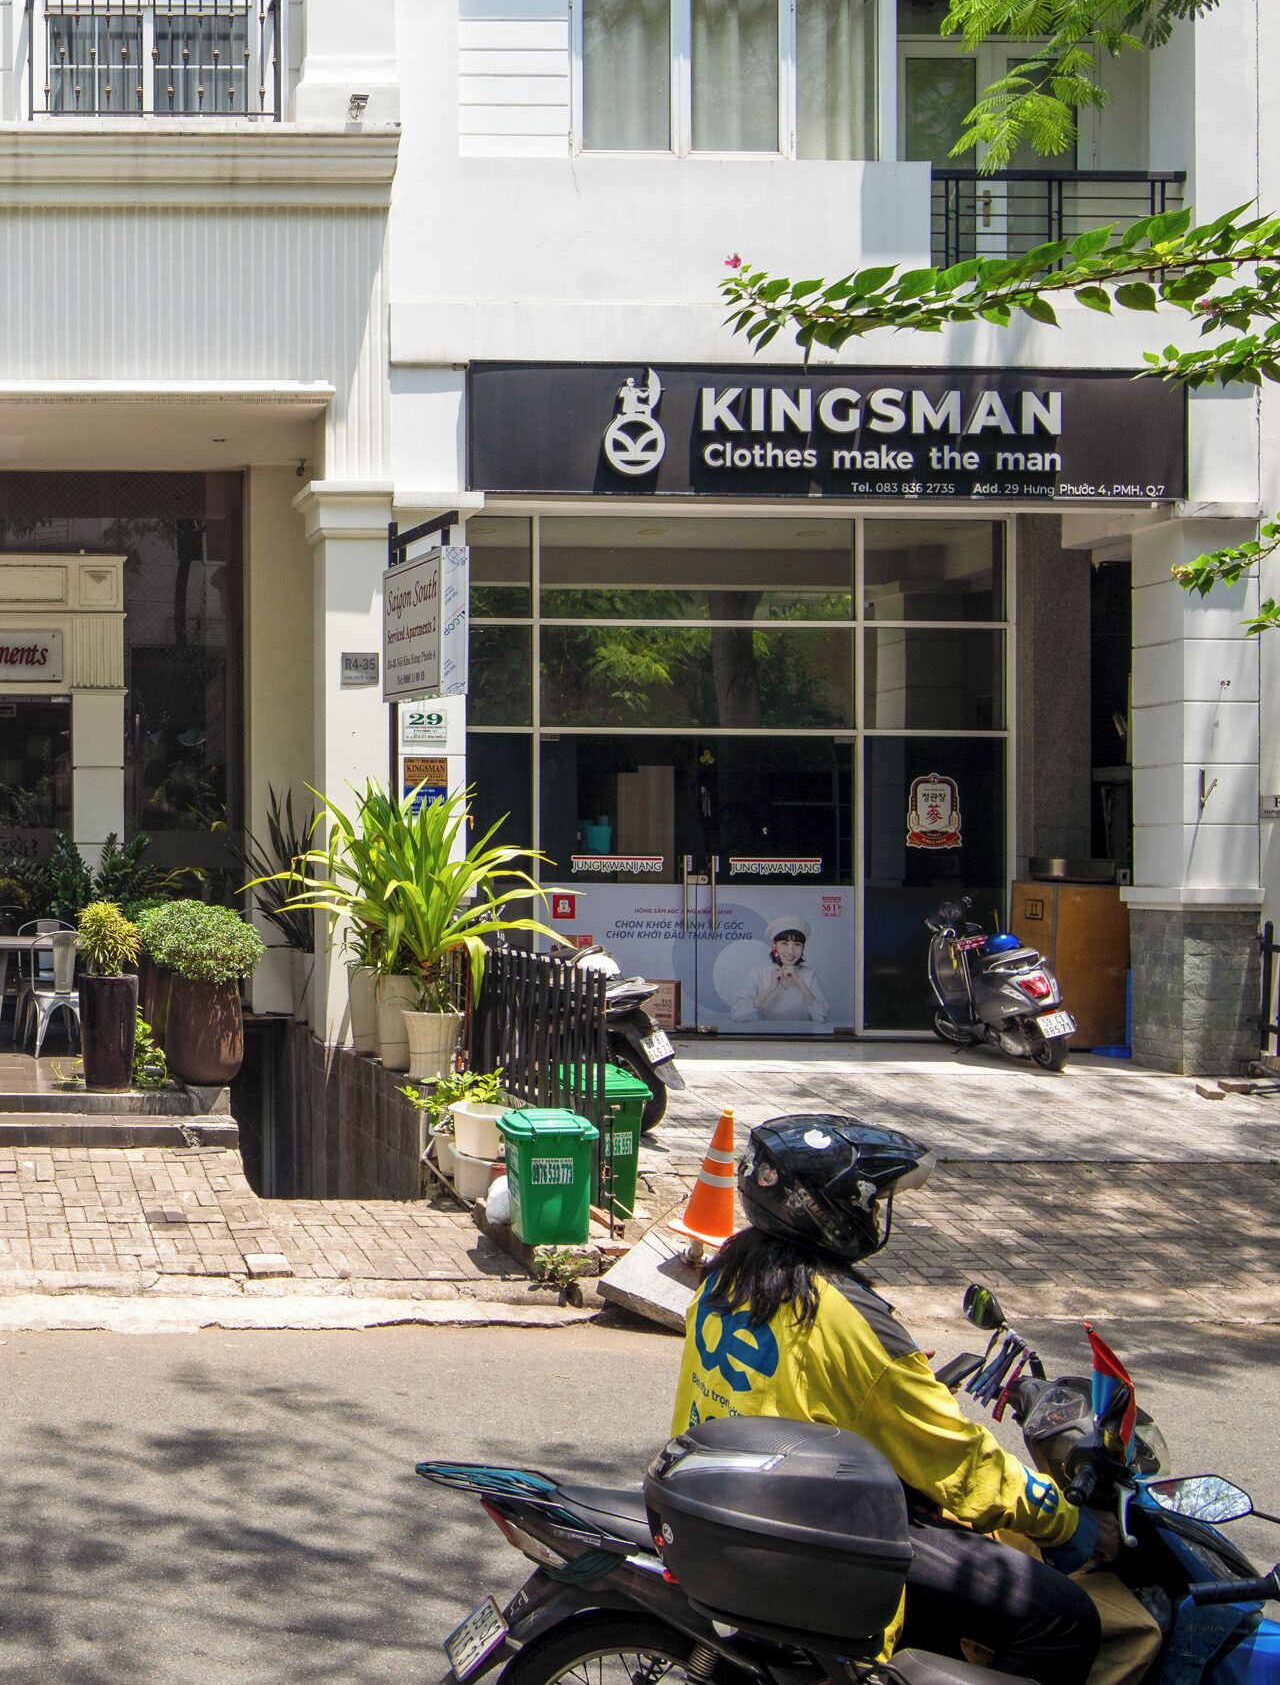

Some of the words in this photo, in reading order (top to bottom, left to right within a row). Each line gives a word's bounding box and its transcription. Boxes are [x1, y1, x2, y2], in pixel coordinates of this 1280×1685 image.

[700, 387, 1062, 435] KINGSMAN
[703, 442, 817, 468] Clothes
[832, 445, 914, 470] make
[930, 446, 980, 471] the
[996, 450, 1062, 472] man
[851, 482, 872, 493] Tel.
[875, 482, 898, 493] 083
[901, 483, 923, 493] 836
[926, 483, 955, 494] 2735
[972, 483, 1001, 494] Add.
[1004, 483, 1019, 494] 29
[1023, 484, 1055, 496] Hưng
[1059, 482, 1095, 495] Phước
[1146, 485, 1165, 497] Q.7
[386, 587, 412, 619] Saigon
[412, 569, 437, 608] South
[387, 625, 405, 645] Serviced
[405, 619, 432, 643] Apartments
[345, 658, 376, 670] R4-35
[409, 713, 443, 726] 29
[407, 764, 445, 772] KINGSMAN
[615, 920, 644, 930] CHỌN
[606, 930, 635, 941] CHỌN
